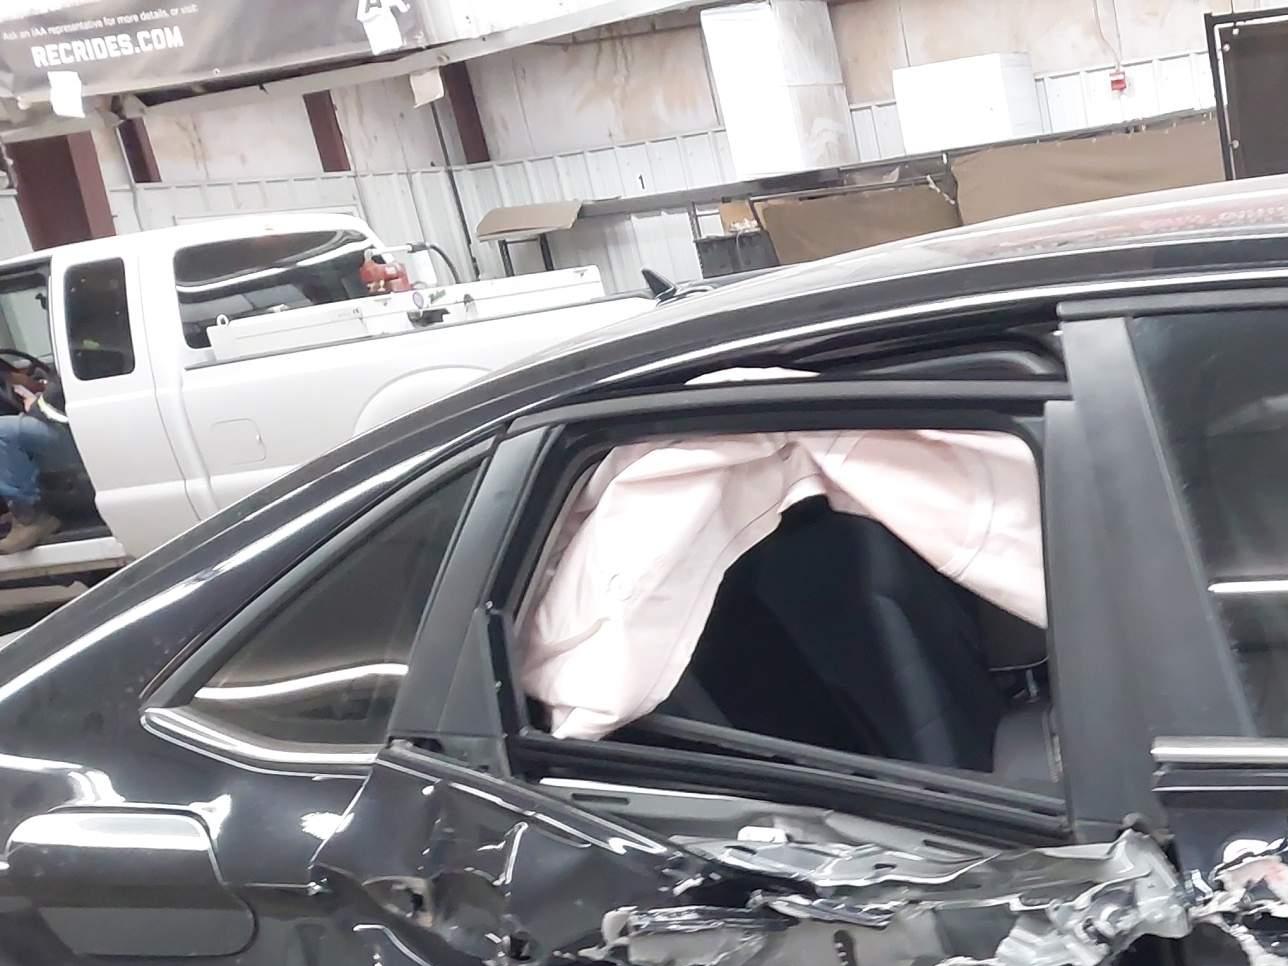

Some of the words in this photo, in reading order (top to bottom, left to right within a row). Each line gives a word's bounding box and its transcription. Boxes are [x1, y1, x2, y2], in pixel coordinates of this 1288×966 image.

[47, 20, 104, 35] representative
[116, 14, 139, 25] more
[31, 25, 184, 68] RECRIDES.COM
